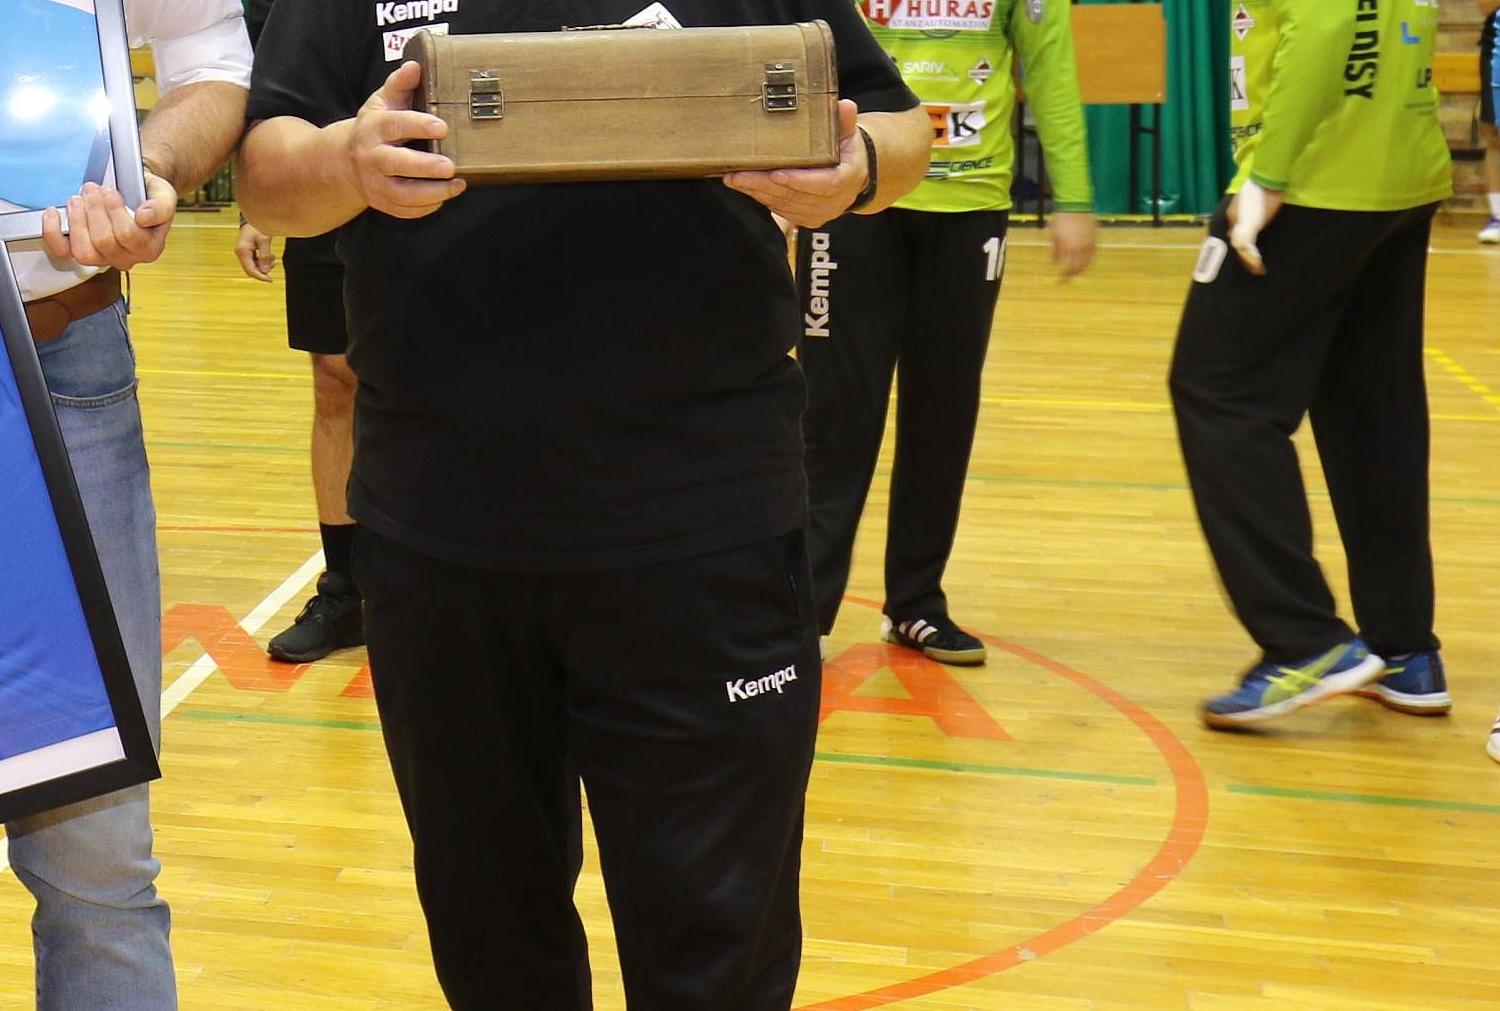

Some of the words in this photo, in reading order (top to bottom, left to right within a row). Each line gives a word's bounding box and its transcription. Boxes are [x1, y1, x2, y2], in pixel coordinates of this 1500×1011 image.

[906, 0, 993, 19] HURAS
[982, 236, 1008, 282] 1
[804, 232, 838, 338] Kempa
[725, 663, 799, 703] Kempa
